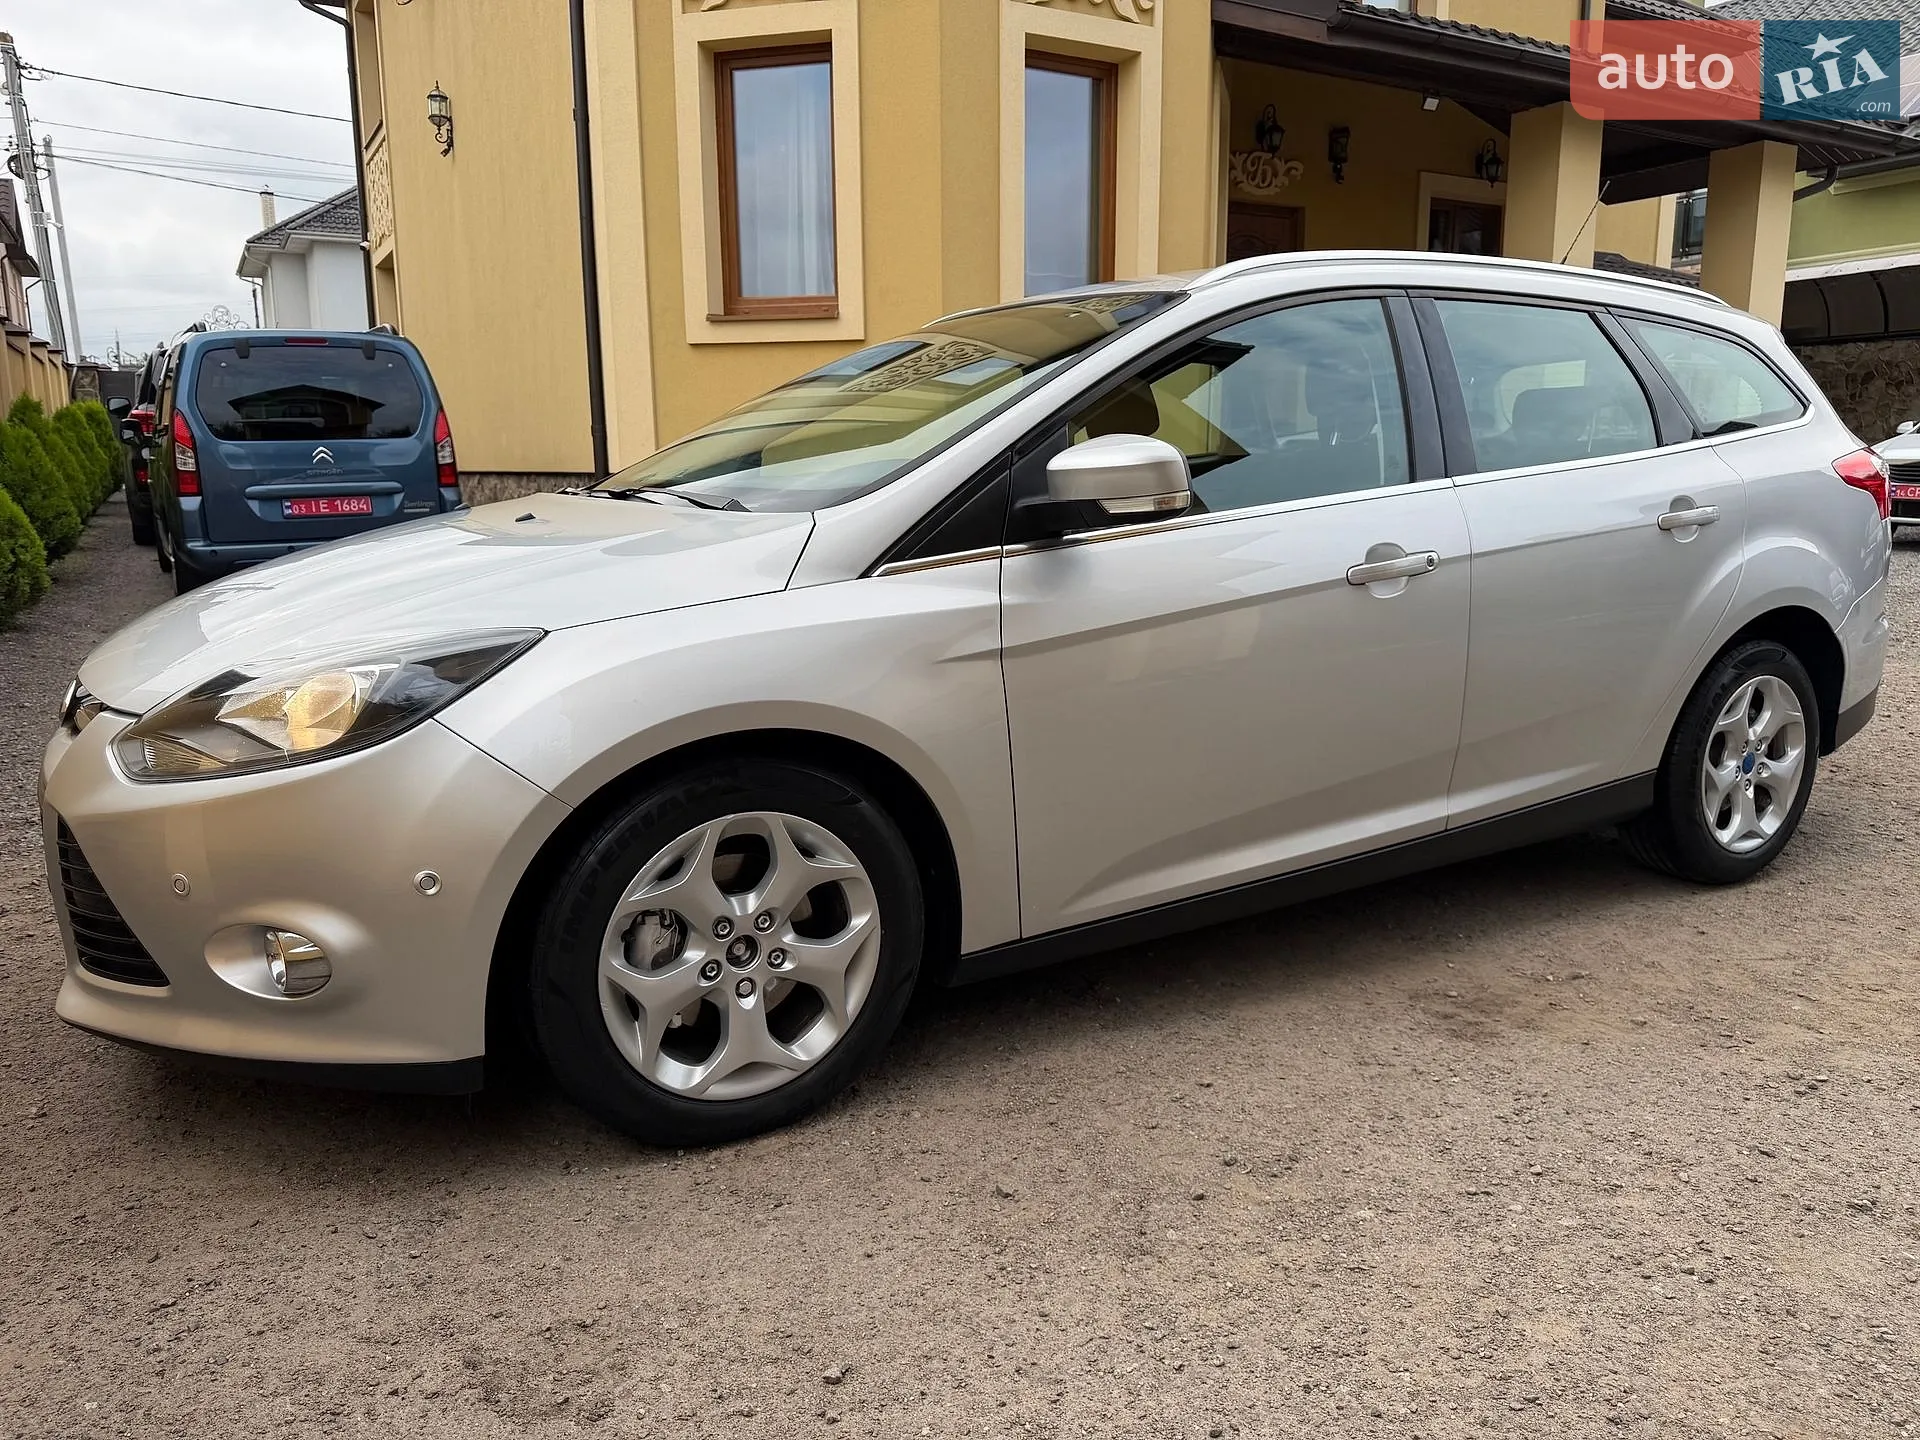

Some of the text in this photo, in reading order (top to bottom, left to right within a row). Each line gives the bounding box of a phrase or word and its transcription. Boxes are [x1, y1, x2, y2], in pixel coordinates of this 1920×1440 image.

[292, 499, 367, 514] 03 IE 1684
